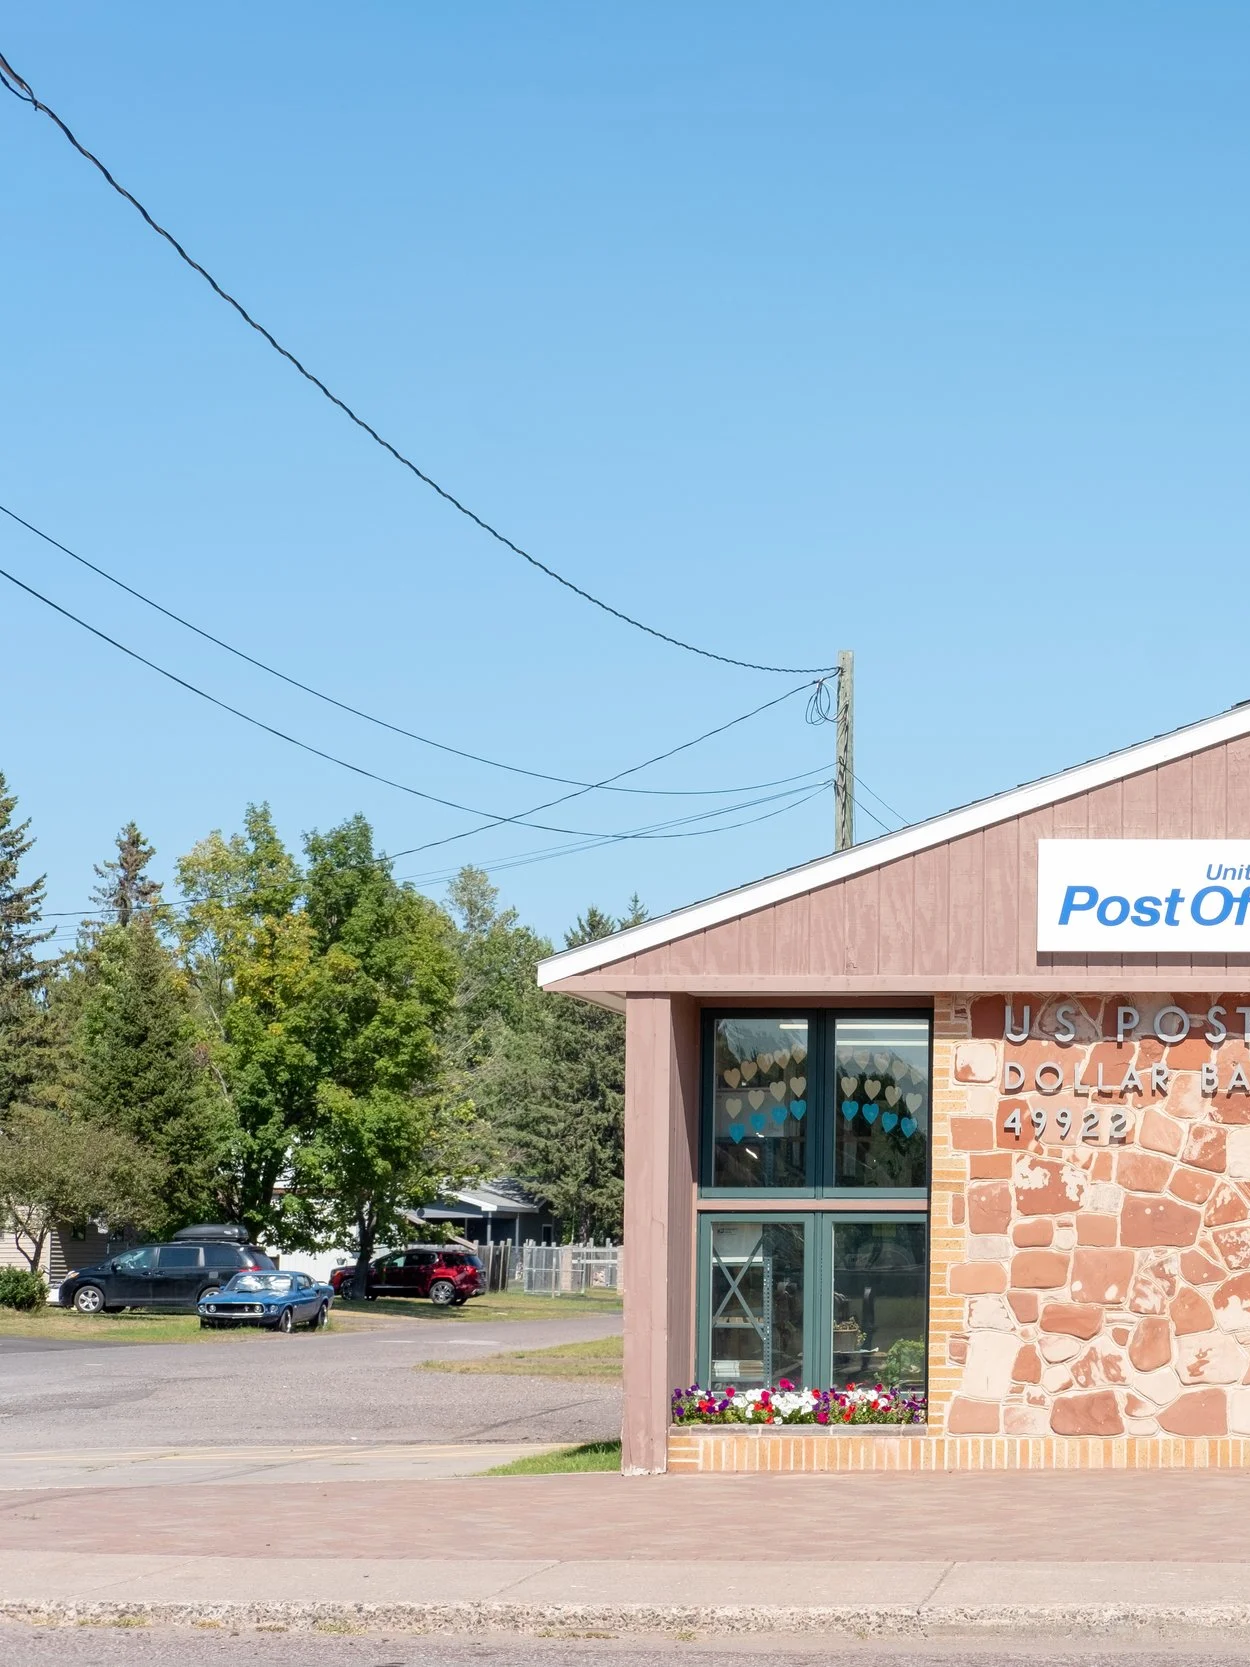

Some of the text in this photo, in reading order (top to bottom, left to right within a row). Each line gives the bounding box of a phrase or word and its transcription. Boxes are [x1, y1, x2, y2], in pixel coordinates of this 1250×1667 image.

[1058, 885, 1186, 927] Post
[1004, 1061, 1170, 1096] DOLLAR
[1003, 1106, 1128, 1140] 49922
